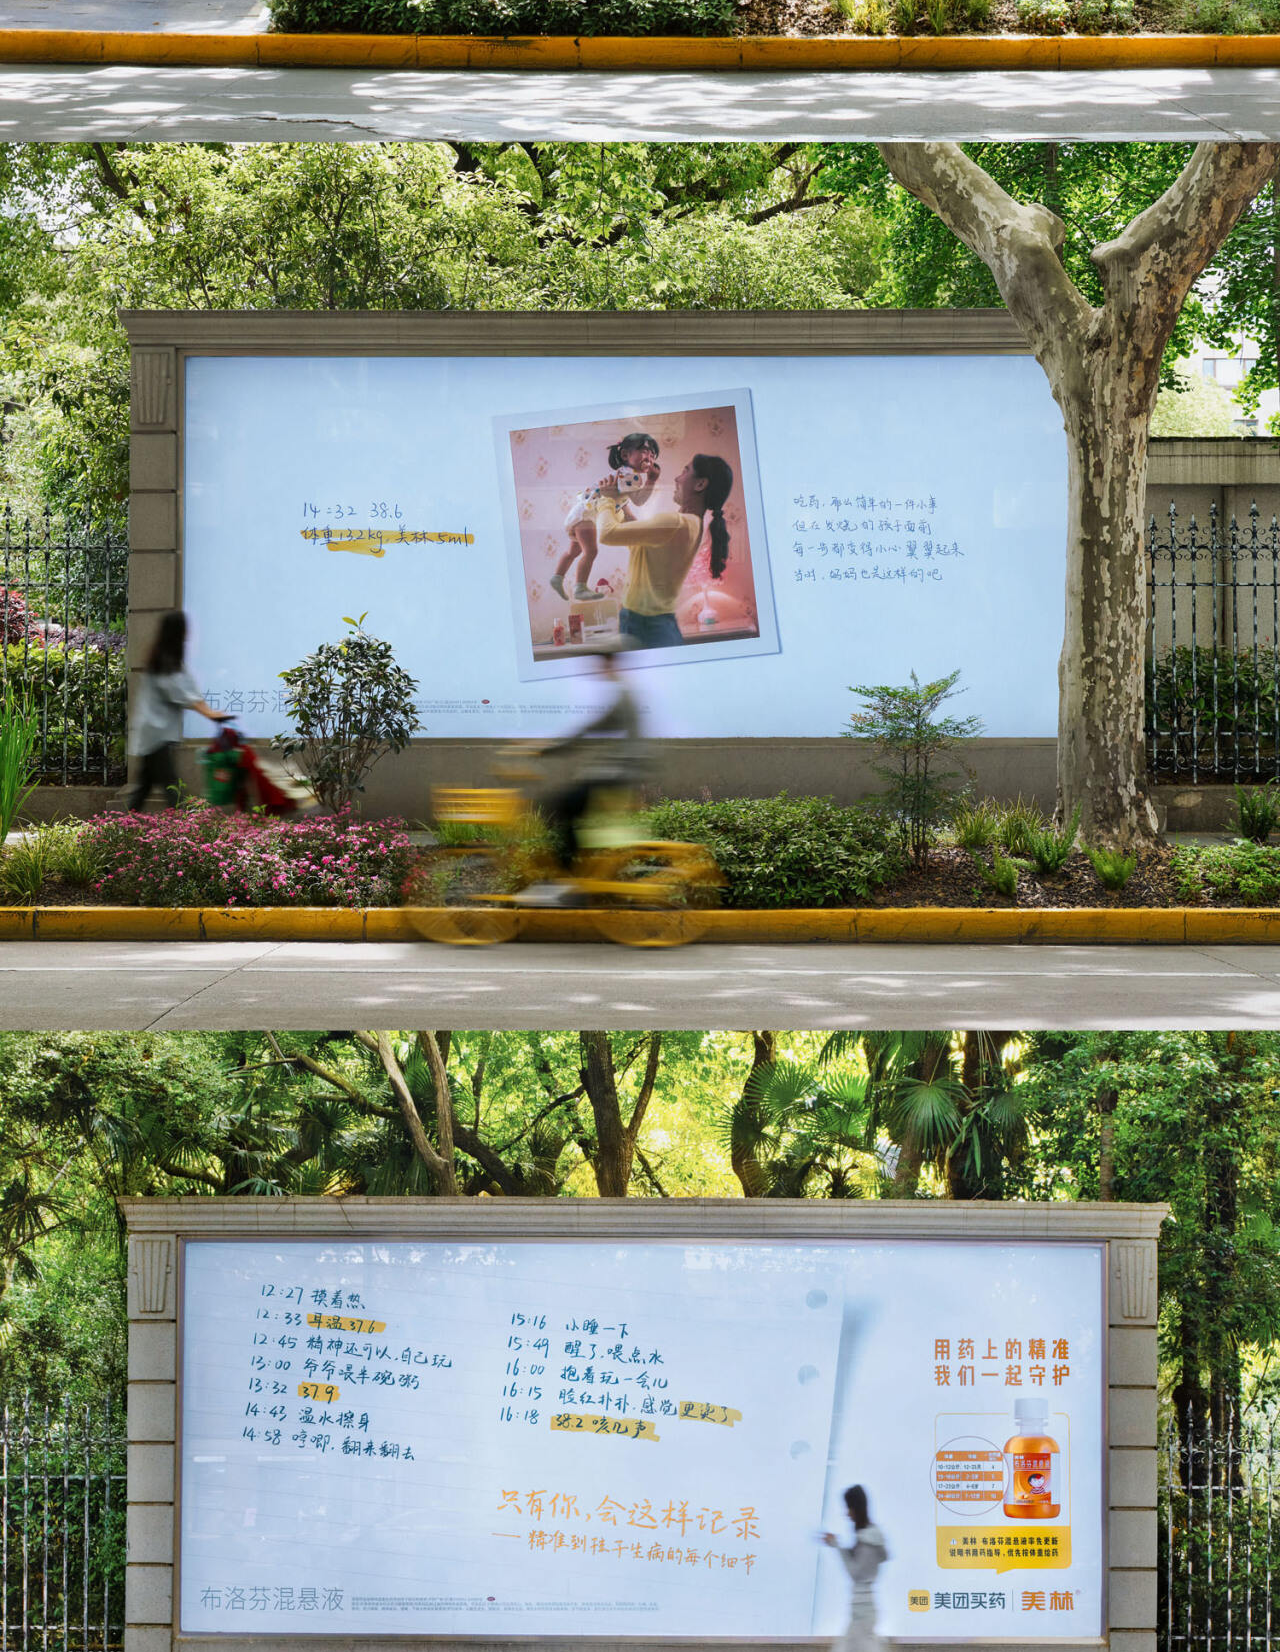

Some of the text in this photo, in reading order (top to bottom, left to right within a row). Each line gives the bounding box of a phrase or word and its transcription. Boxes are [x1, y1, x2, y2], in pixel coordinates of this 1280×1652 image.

[303, 501, 403, 519] 14:32 38.6
[261, 1284, 366, 1310] 12:27 摸着热
[256, 1308, 375, 1334] 12:33 耳温37.6
[511, 1313, 632, 1338] 15:16 小睡一下
[253, 1333, 298, 1349] 12:45
[508, 1335, 550, 1358] 15:49
[934, 1338, 1070, 1361] 用药上的精准
[251, 1355, 420, 1390] 13:00 爷爷喂半碗粥
[506, 1357, 668, 1390] 16:00 抱着玩一会儿
[934, 1364, 1070, 1387] 我们一起守护
[249, 1377, 335, 1404] 13:32 37.9
[503, 1384, 542, 1401] 16:15
[245, 1402, 370, 1432] 14:43 温水擦身
[500, 1407, 539, 1425] 16:18
[242, 1426, 283, 1445] 14:58
[497, 1489, 761, 1541] 只有你，会这样记录
[200, 1586, 345, 1612] 布洛芬混悬液
[934, 1590, 1075, 1611] 美团买药 美林
